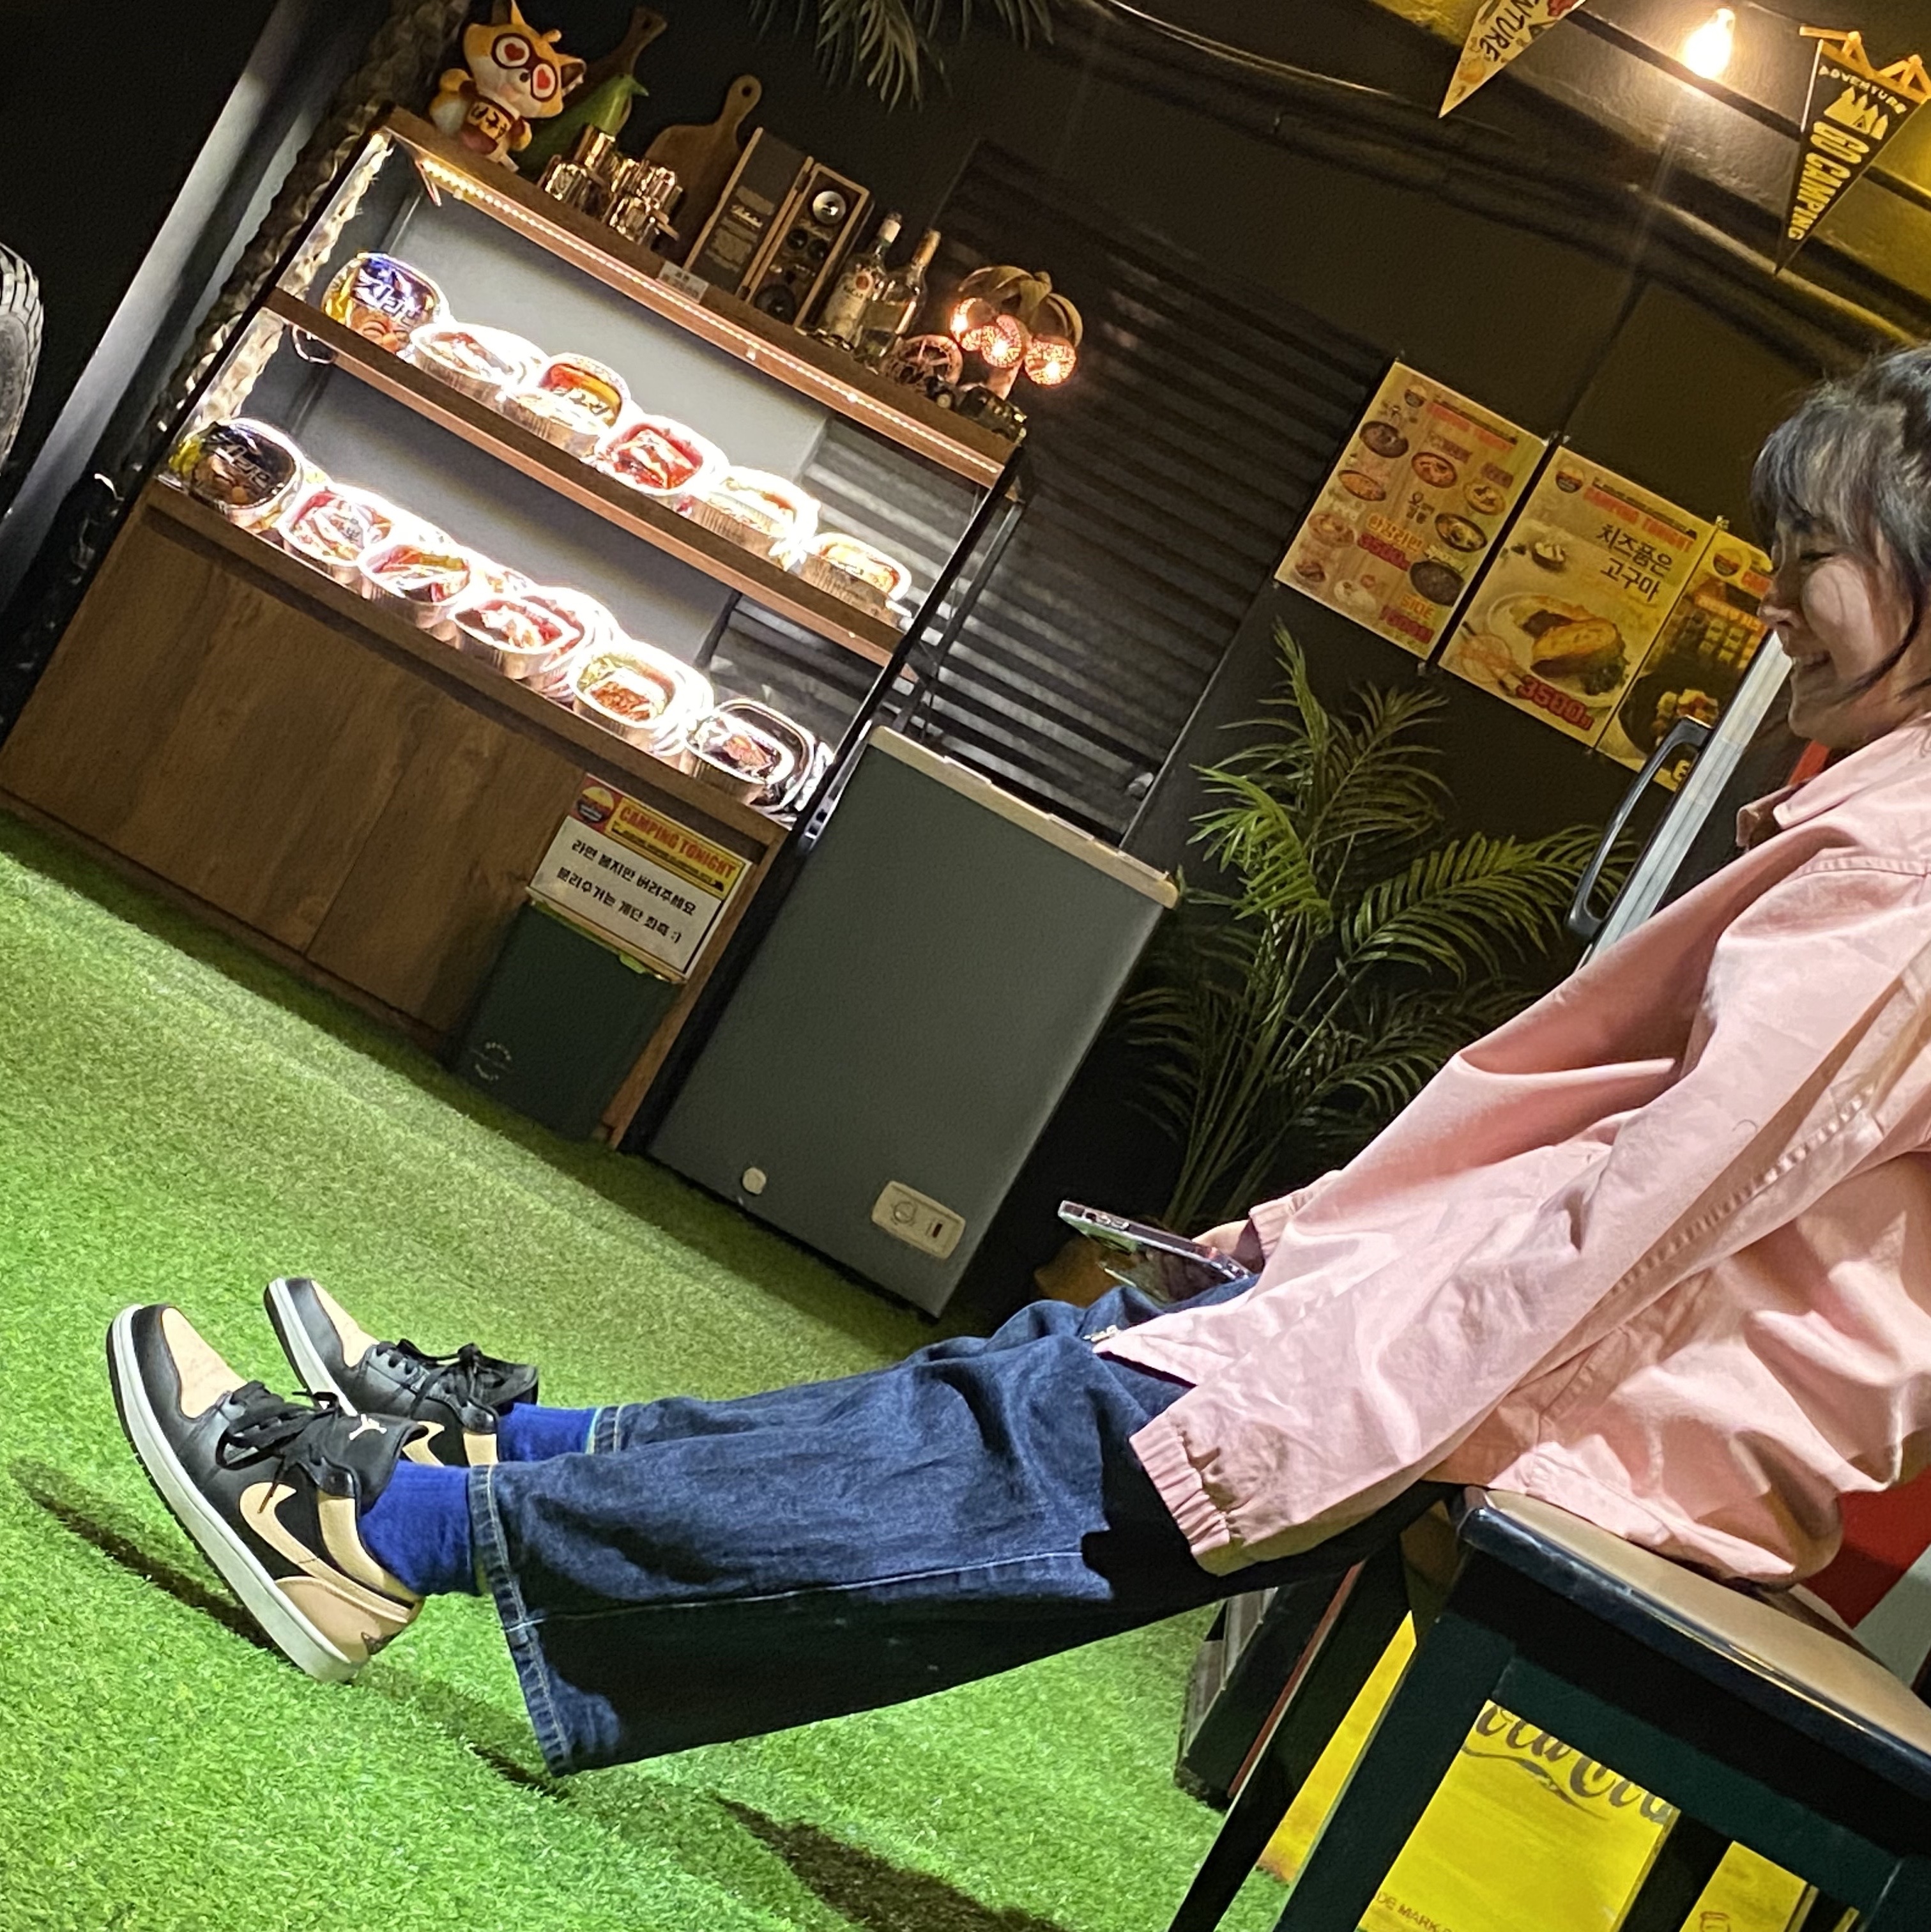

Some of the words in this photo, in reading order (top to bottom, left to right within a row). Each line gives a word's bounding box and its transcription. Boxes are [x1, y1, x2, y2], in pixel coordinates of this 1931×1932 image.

[1819, 65, 1907, 114] ADVENTURE
[1810, 121, 1870, 164] GO
[1788, 152, 1851, 240] CAMPING
[1596, 524, 1672, 578] 치즈품은
[1600, 557, 1660, 602] 고구마
[619, 806, 680, 849] CAMPING
[678, 839, 736, 878] TONIGHT
[556, 866, 616, 907] 분리수거는
[618, 900, 644, 923] 계단
[572, 839, 598, 861] 라면
[636, 876, 696, 916] 버려주세요
[1397, 1903, 1441, 1932] MARK
